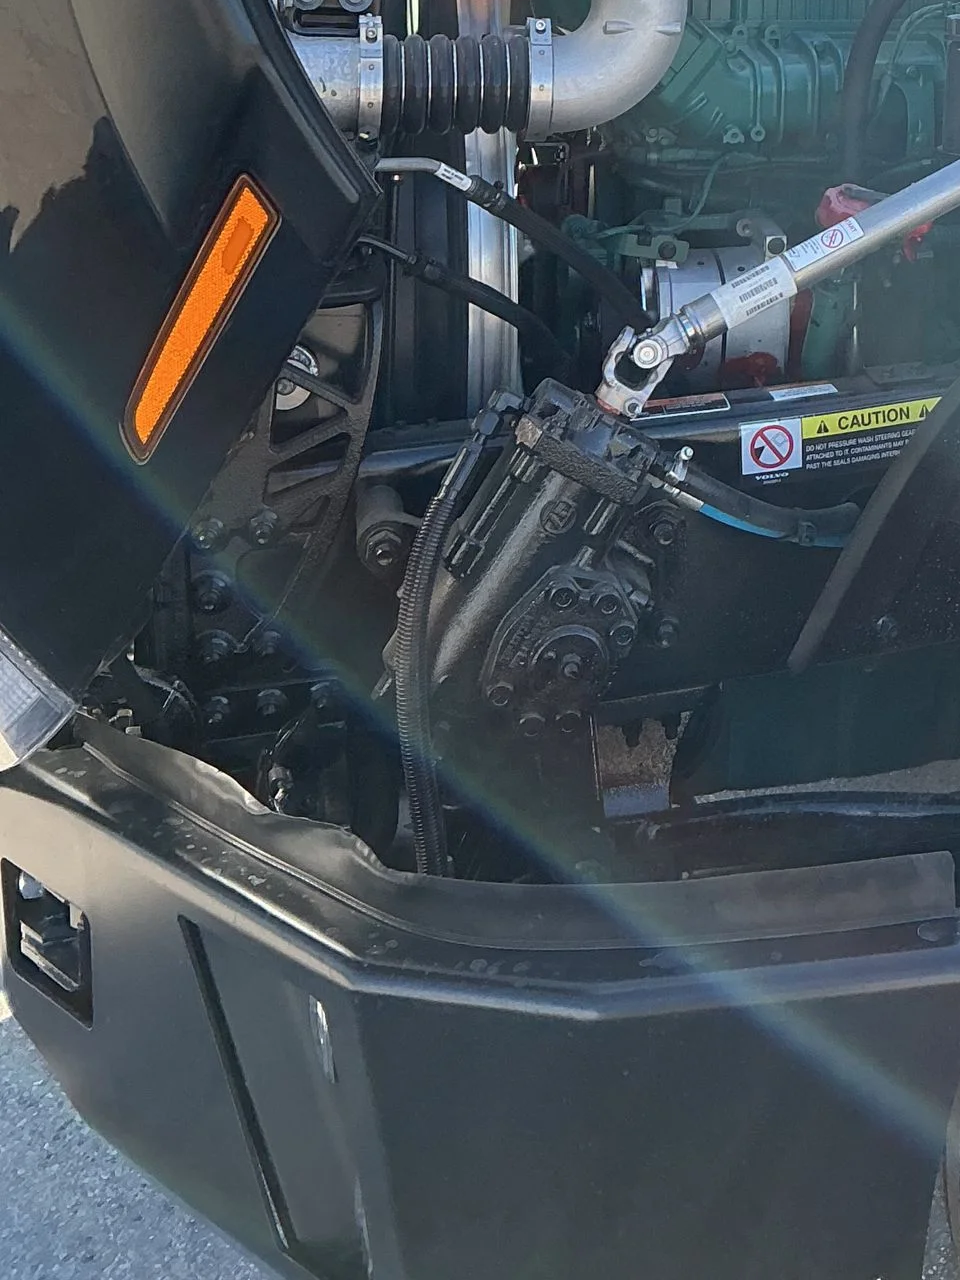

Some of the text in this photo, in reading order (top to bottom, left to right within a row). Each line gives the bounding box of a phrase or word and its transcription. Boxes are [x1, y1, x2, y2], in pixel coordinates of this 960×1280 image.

[837, 406, 910, 430] CAUTION
[815, 442, 828, 451] NOT
[828, 438, 857, 448] PRESSURE
[857, 435, 874, 444] WASH
[806, 451, 834, 461] ATTACHED
[755, 471, 789, 481] VOLVO
